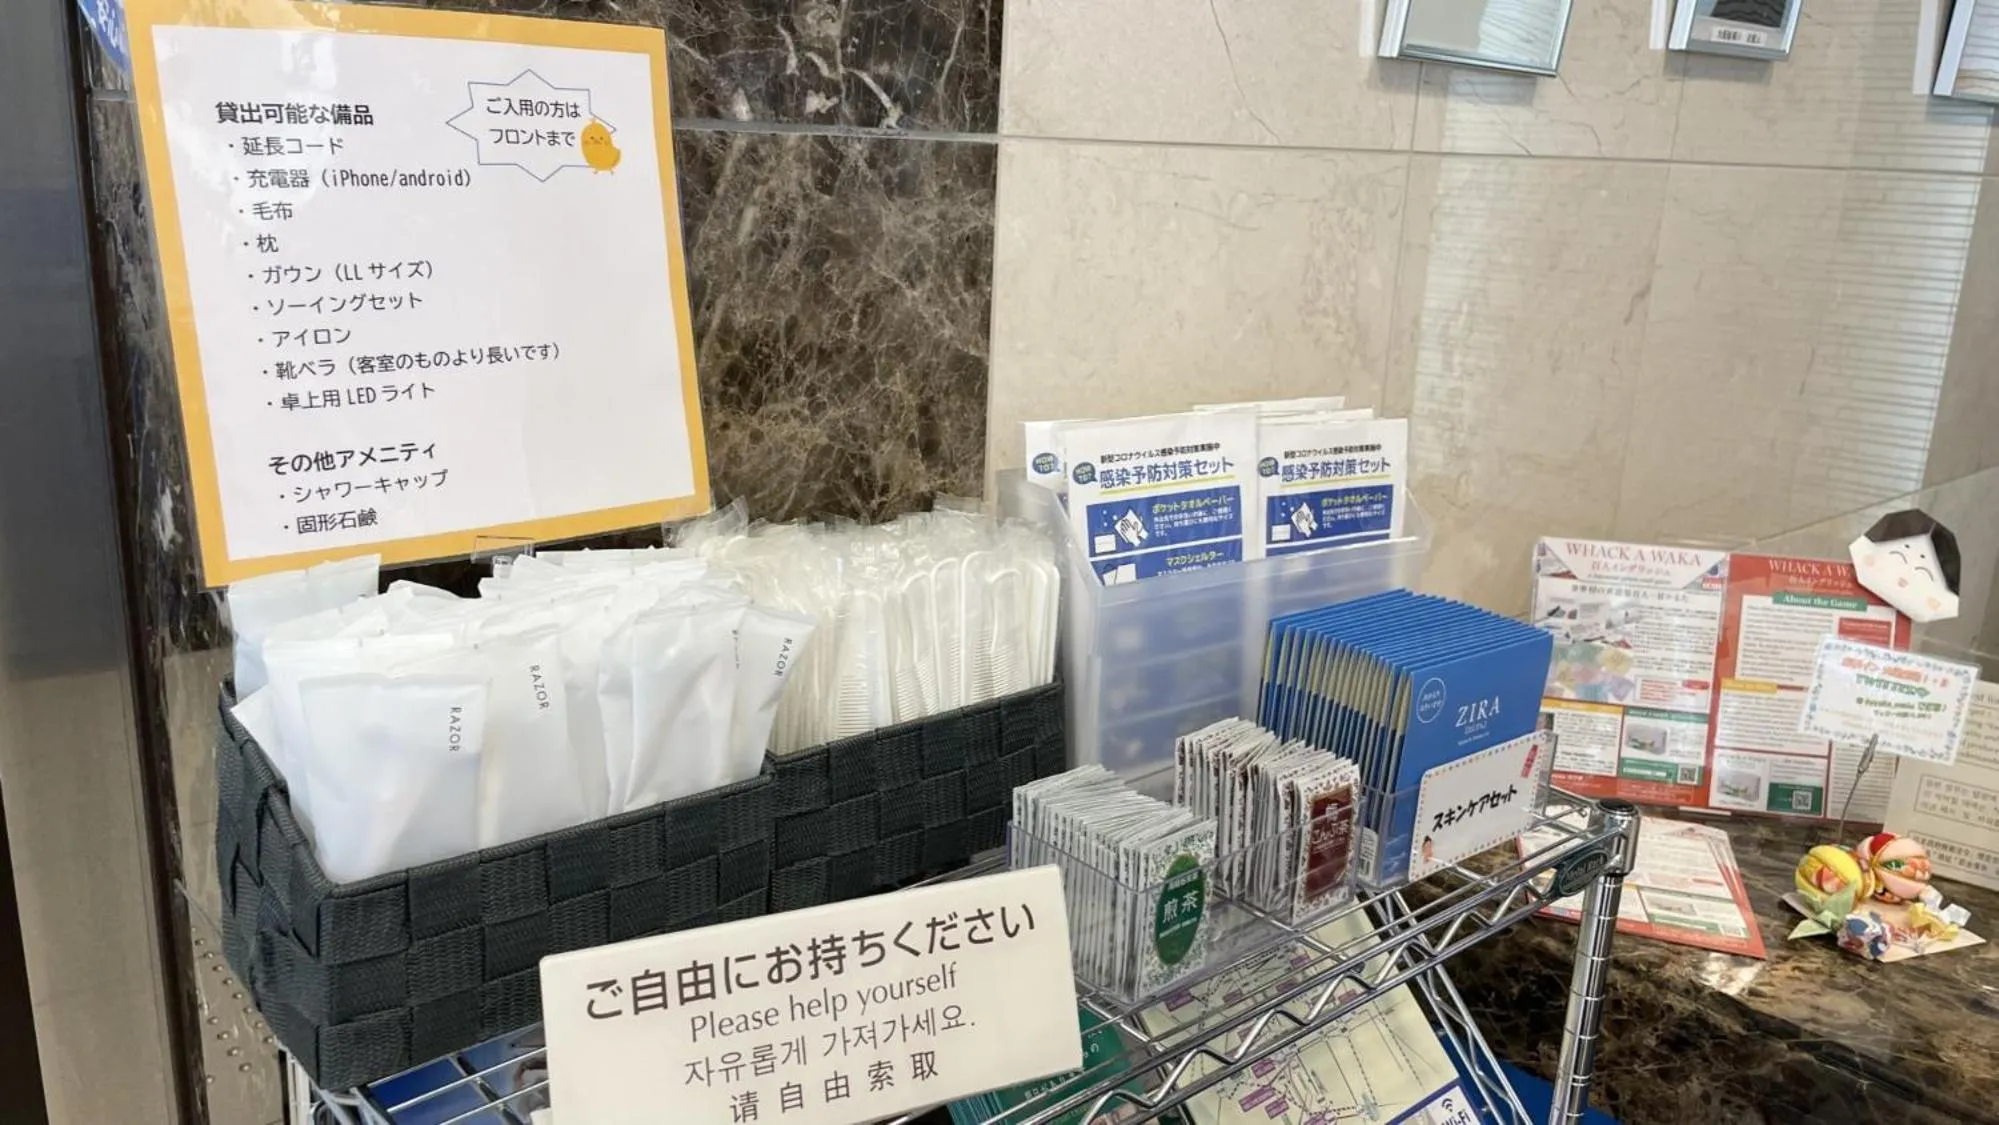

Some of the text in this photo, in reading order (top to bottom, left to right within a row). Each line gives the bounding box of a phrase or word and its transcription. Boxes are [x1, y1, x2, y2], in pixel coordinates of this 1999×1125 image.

[216, 101, 374, 127] 貸出可能な備品
[487, 97, 581, 119] ご入用の方は
[489, 127, 575, 147] フロントまで
[268, 442, 437, 476] その他アメニティ
[1100, 456, 1234, 489] 感染予防対策セット
[1281, 457, 1391, 482] 感染予防対策セット
[1565, 542, 1701, 567] WHACK A WAKA
[1769, 559, 1820, 575] WHACK
[1783, 594, 1858, 609] About the Game
[774, 637, 793, 677] RAZOR
[529, 664, 550, 710] RAZOR
[1455, 695, 1500, 728] ZIRA
[448, 706, 462, 752] RAZOR
[1432, 784, 1518, 833] スキンケアセット
[584, 903, 1036, 1022] ご自由にお持ちください
[690, 962, 959, 1043] Please help yourself
[684, 1002, 976, 1090] 자유롭게 가져가세요.
